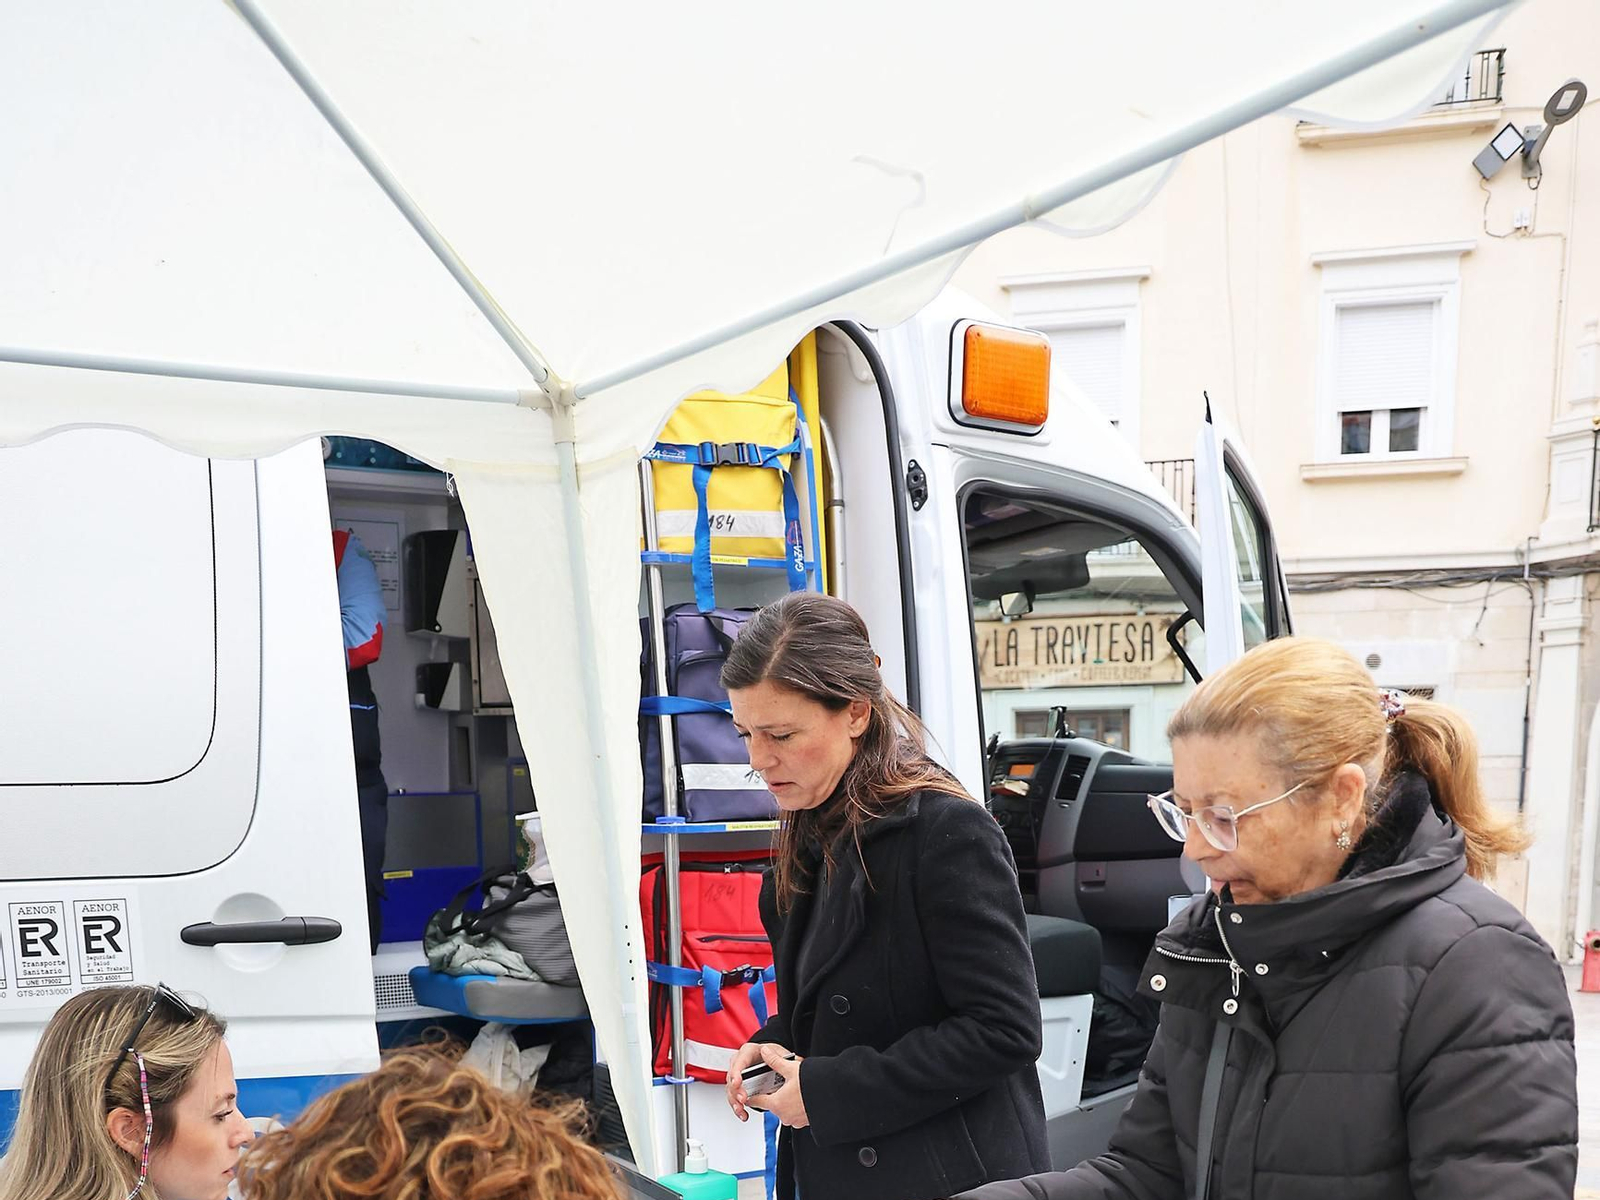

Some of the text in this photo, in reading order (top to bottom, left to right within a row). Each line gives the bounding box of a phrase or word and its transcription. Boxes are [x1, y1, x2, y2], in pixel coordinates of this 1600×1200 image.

[794, 545, 804, 572] GAZA
[993, 622, 1154, 667] LA TRAVIESA
[17, 905, 57, 916] AENOR
[82, 903, 120, 913] AENOR
[22, 959, 66, 968] Transporte
[23, 968, 63, 976] Sanitario
